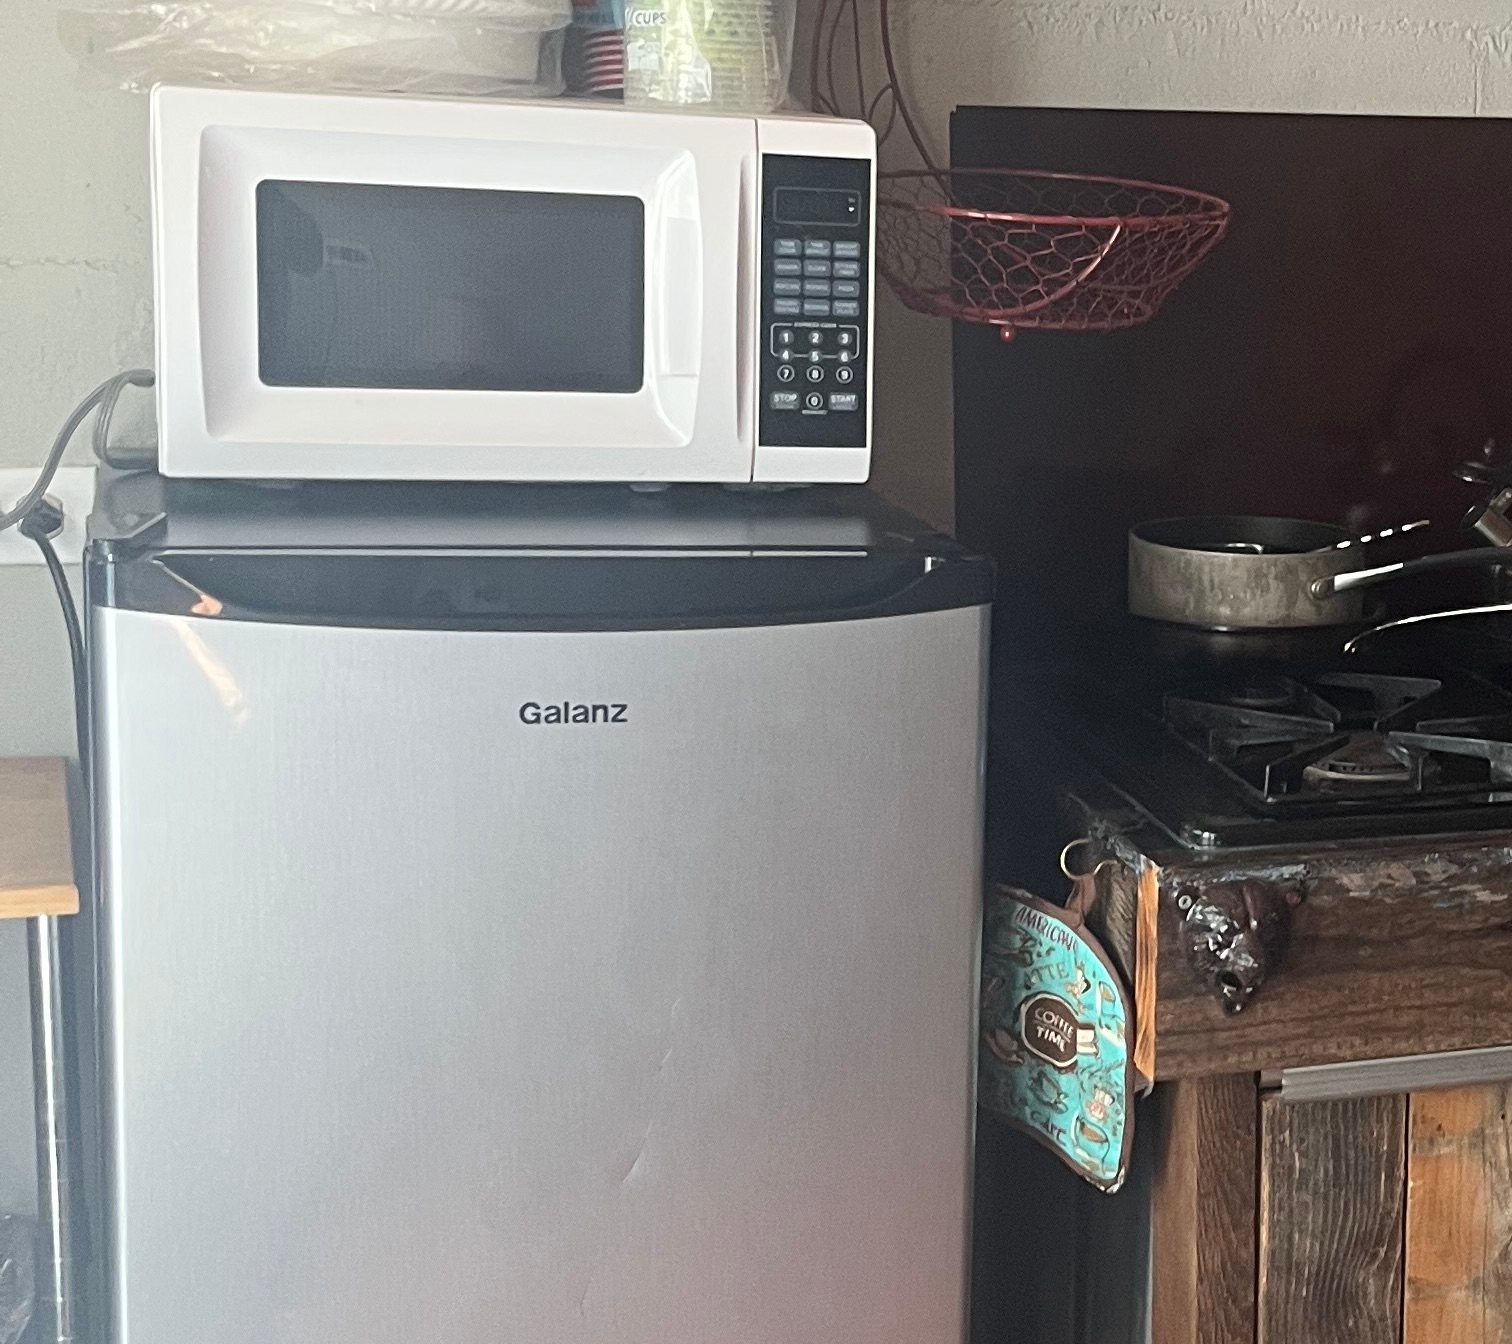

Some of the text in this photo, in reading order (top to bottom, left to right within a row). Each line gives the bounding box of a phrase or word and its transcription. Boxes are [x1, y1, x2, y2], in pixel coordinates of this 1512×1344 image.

[634, 12, 667, 26] CUPS
[773, 393, 798, 403] STOP
[830, 394, 856, 403] START
[518, 701, 629, 725] Galanz
[1034, 1007, 1075, 1039] COFFEE
[1036, 1025, 1068, 1053] TIME
